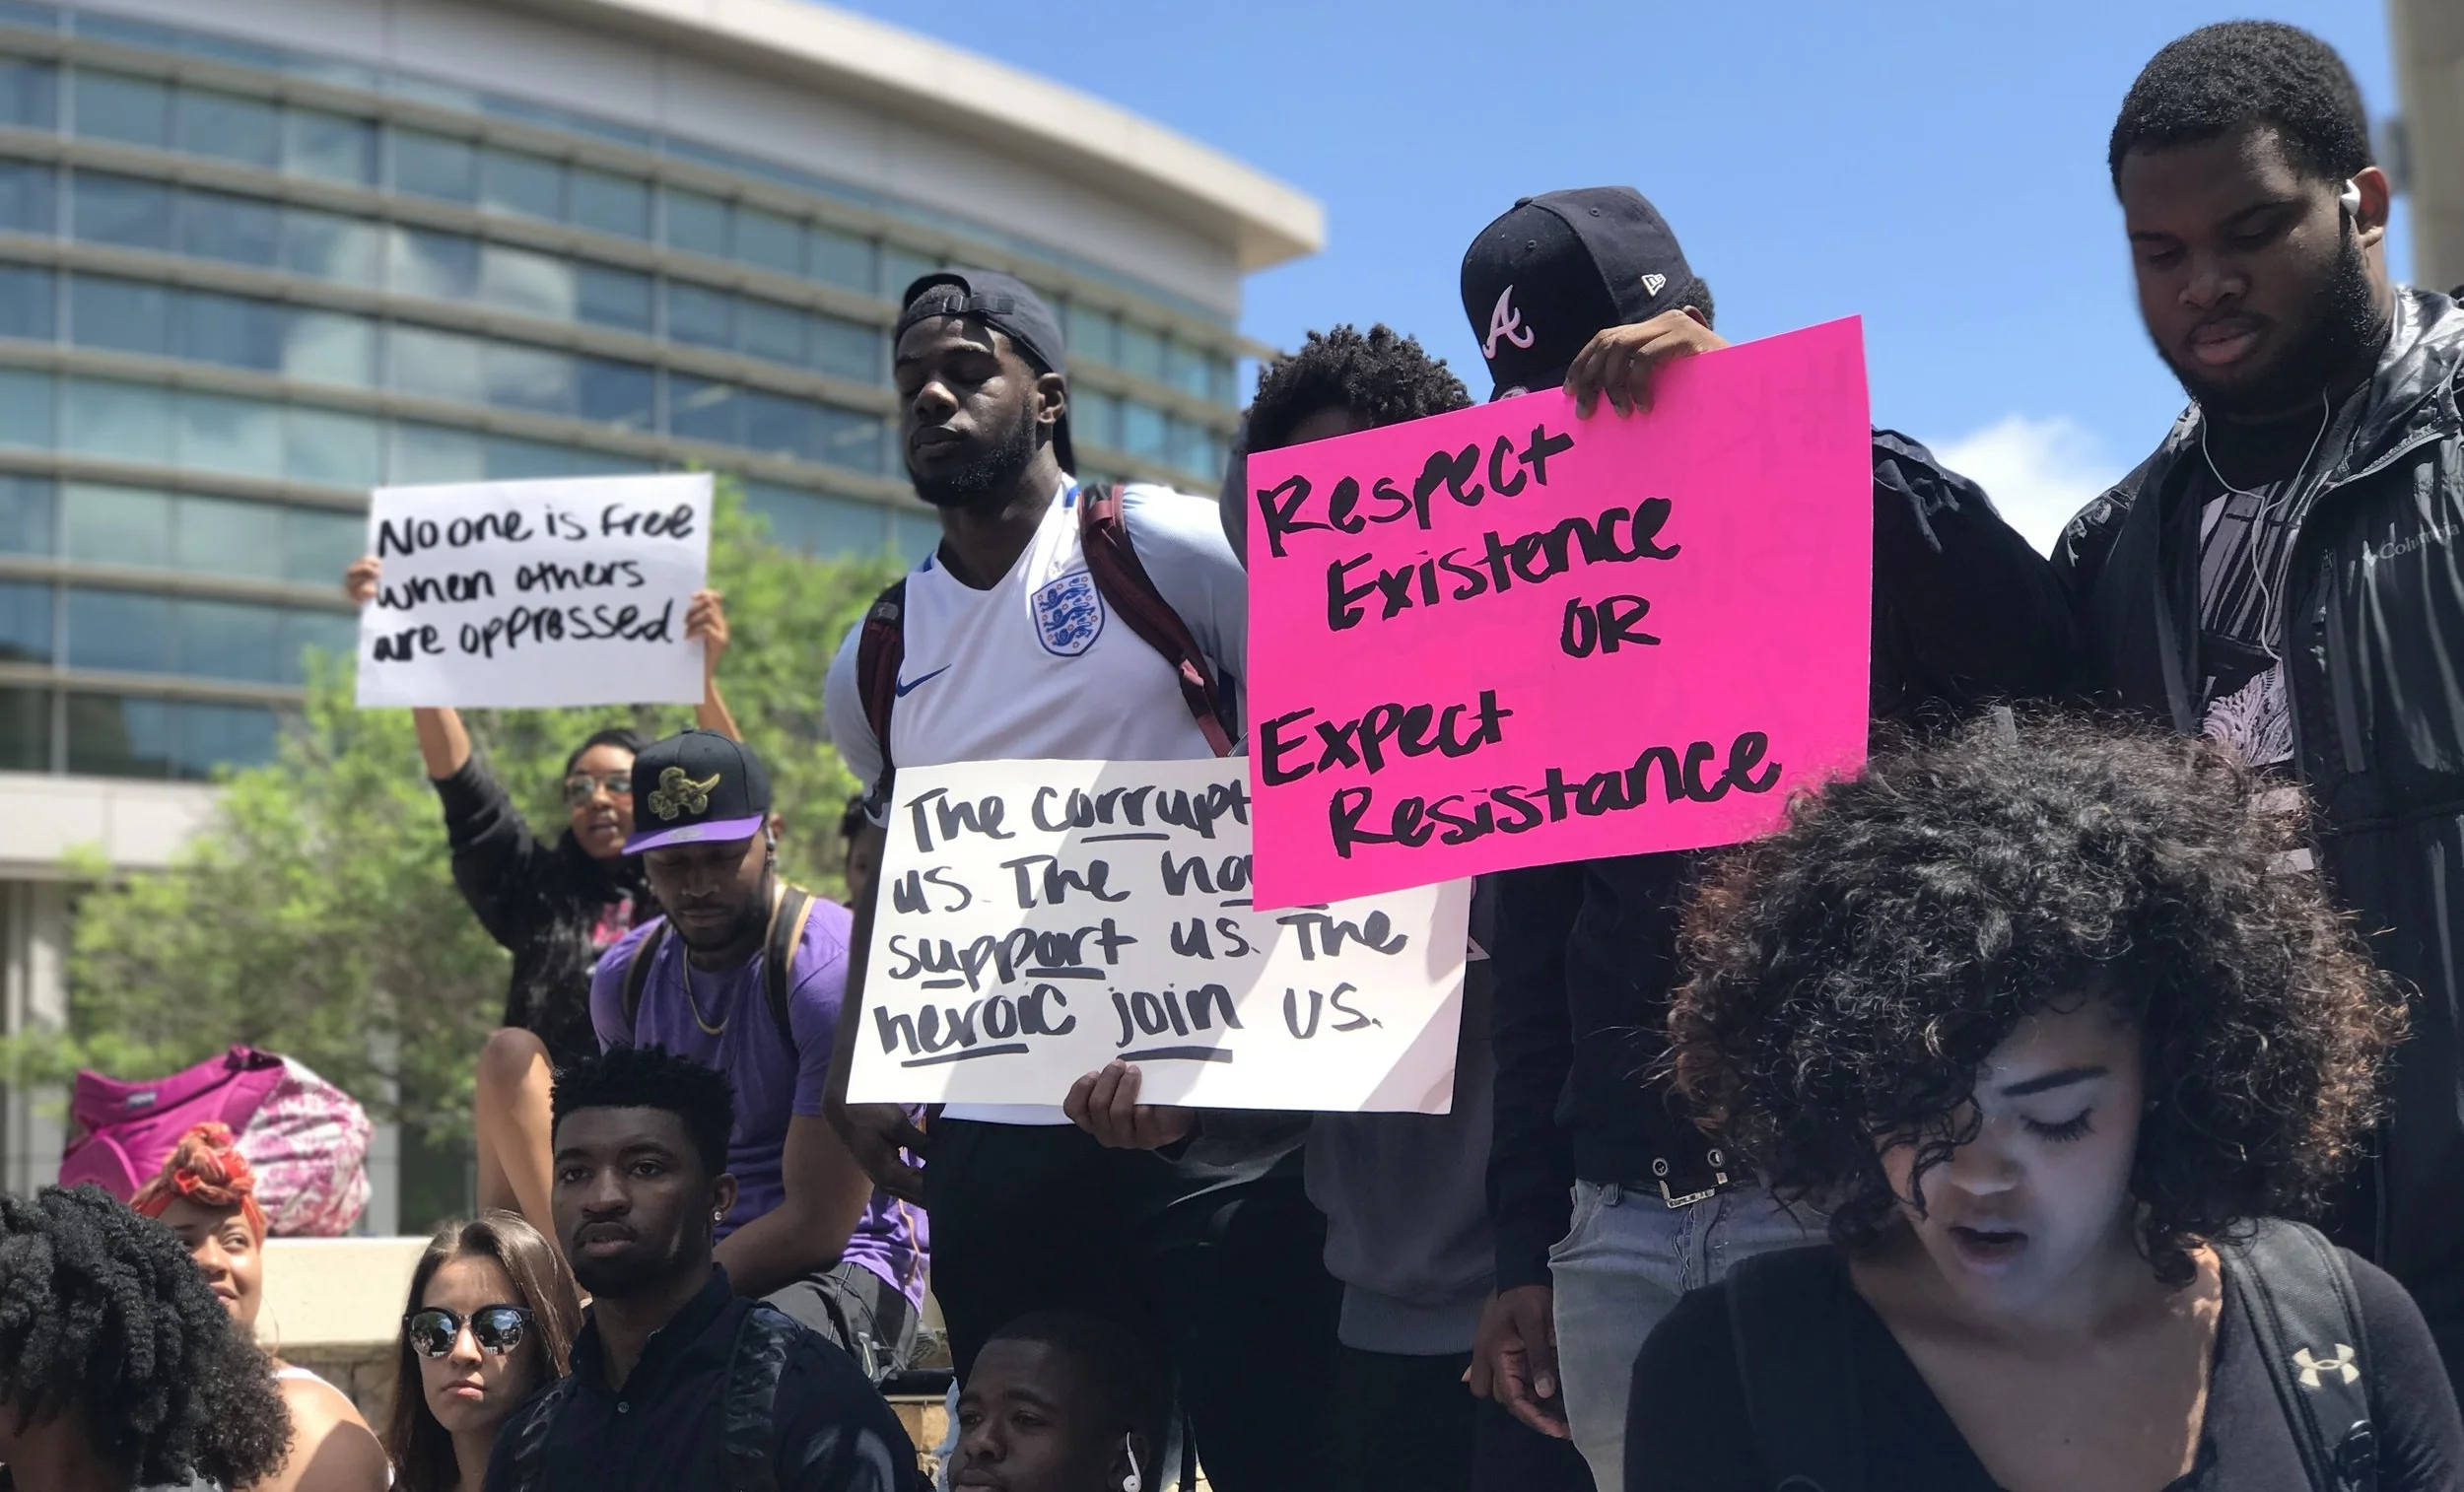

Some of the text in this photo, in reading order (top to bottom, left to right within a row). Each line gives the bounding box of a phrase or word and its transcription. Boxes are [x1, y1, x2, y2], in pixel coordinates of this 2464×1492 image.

[1257, 423, 1575, 559] Respect
[376, 516, 440, 559] No
[544, 504, 587, 541] is
[1327, 497, 1682, 633] Existence
[376, 559, 647, 612] when others
[372, 598, 675, 663] are oppressed
[1559, 594, 1662, 659] OR
[1260, 689, 1514, 787] Expect
[903, 786, 1016, 853] The
[1329, 730, 1783, 859] Resistance
[999, 852, 1131, 910] The
[888, 916, 1138, 993] support
[1276, 910, 1409, 962] The
[874, 983, 1076, 1054] heroic
[1107, 983, 1246, 1050] join
